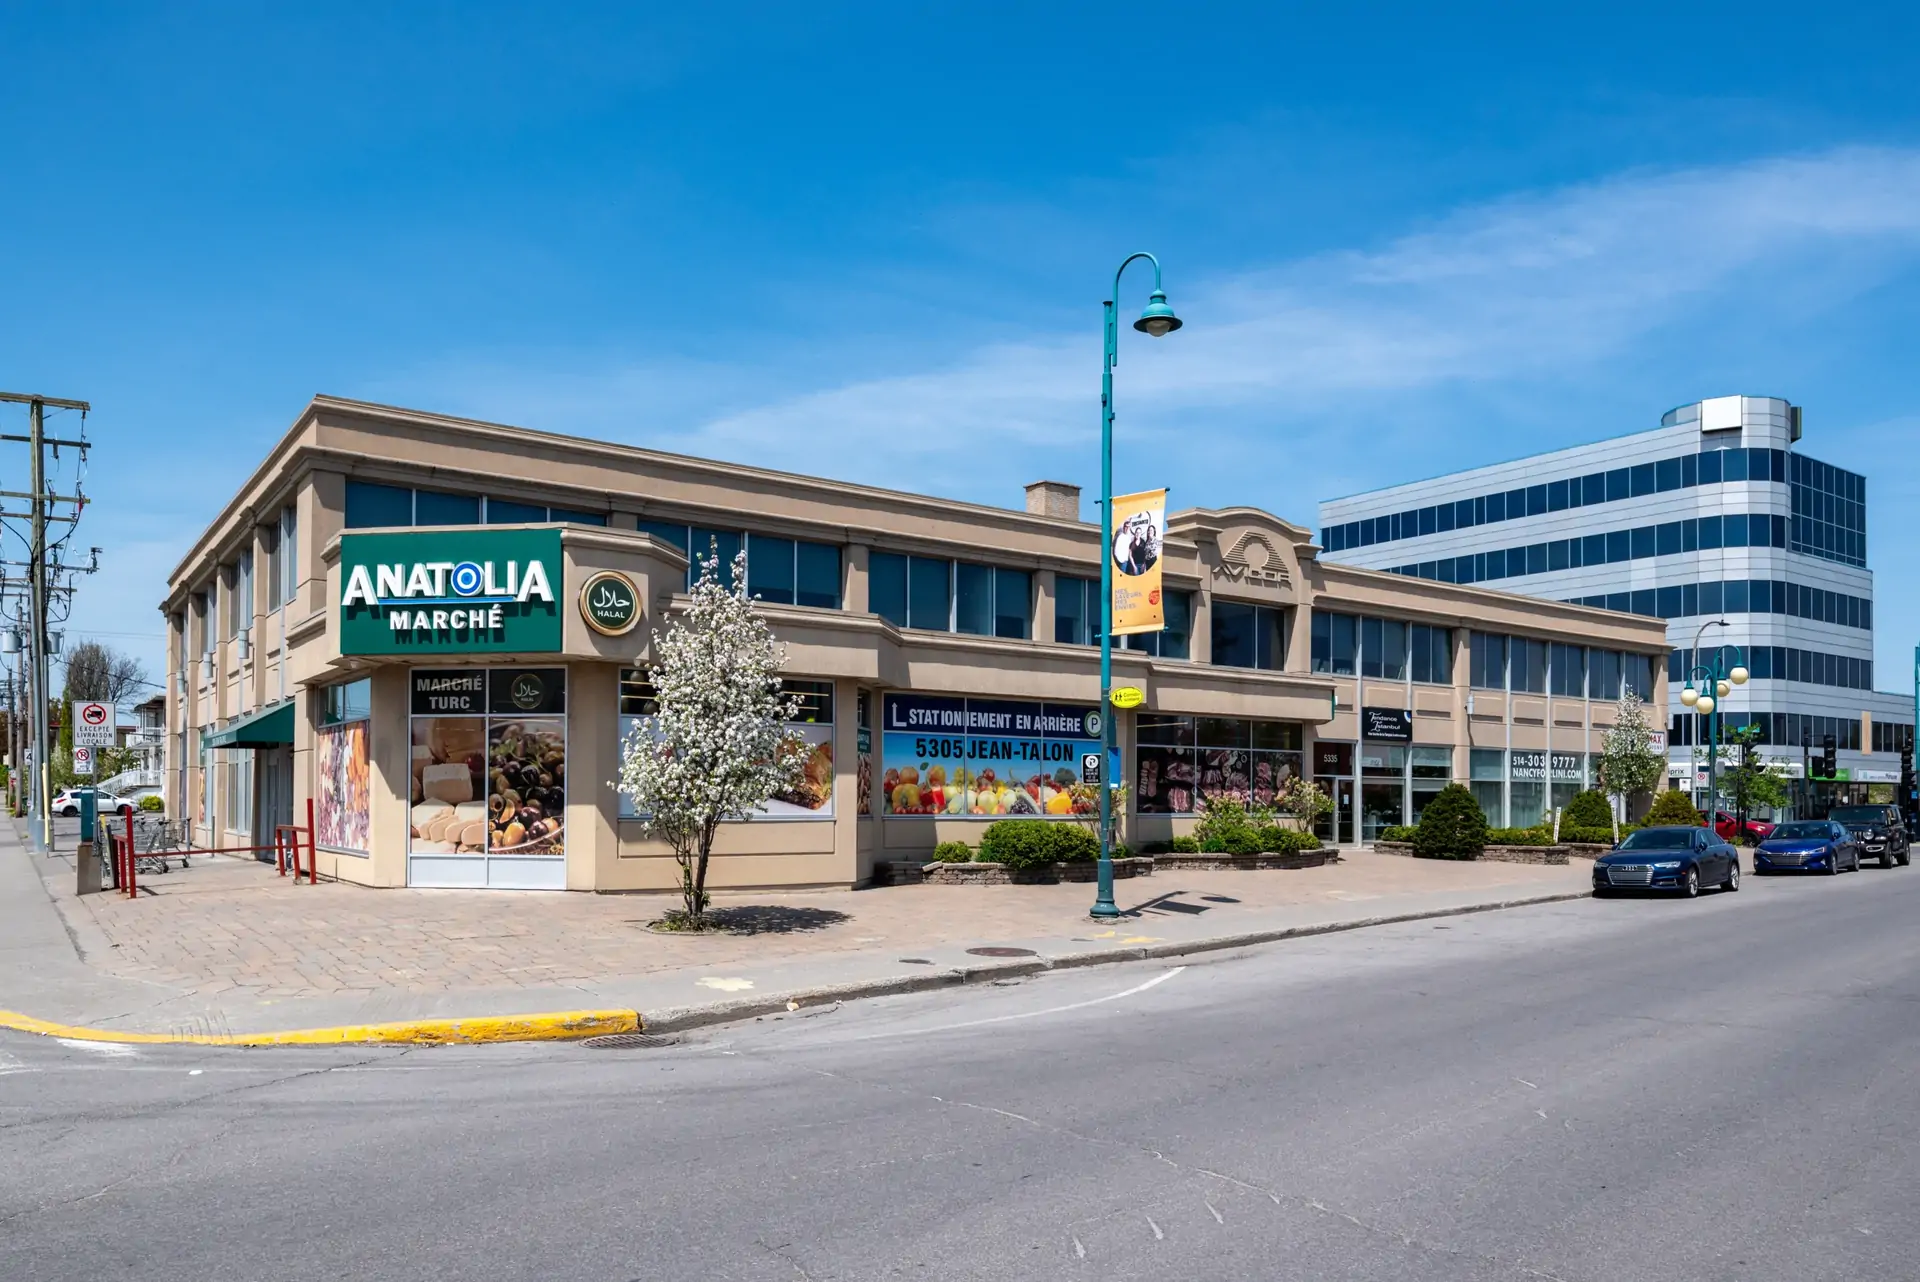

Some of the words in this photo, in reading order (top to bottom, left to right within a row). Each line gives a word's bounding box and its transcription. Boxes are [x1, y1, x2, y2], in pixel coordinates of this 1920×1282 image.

[341, 560, 555, 606] ANATOLIA
[593, 586, 630, 608] حلال
[390, 604, 504, 630] MARCHÉ
[597, 610, 625, 619] HALAL
[417, 675, 483, 692] MARCHÉ
[429, 696, 471, 710] TURC
[1016, 714, 1031, 730] EN
[1033, 712, 1081, 732] ARRIÈRE
[916, 738, 964, 758] 5305
[966, 740, 1074, 761] JEAN-TALON
[1323, 754, 1338, 762] 5335
[1513, 768, 1582, 779] NANCYFOLINI.COM
